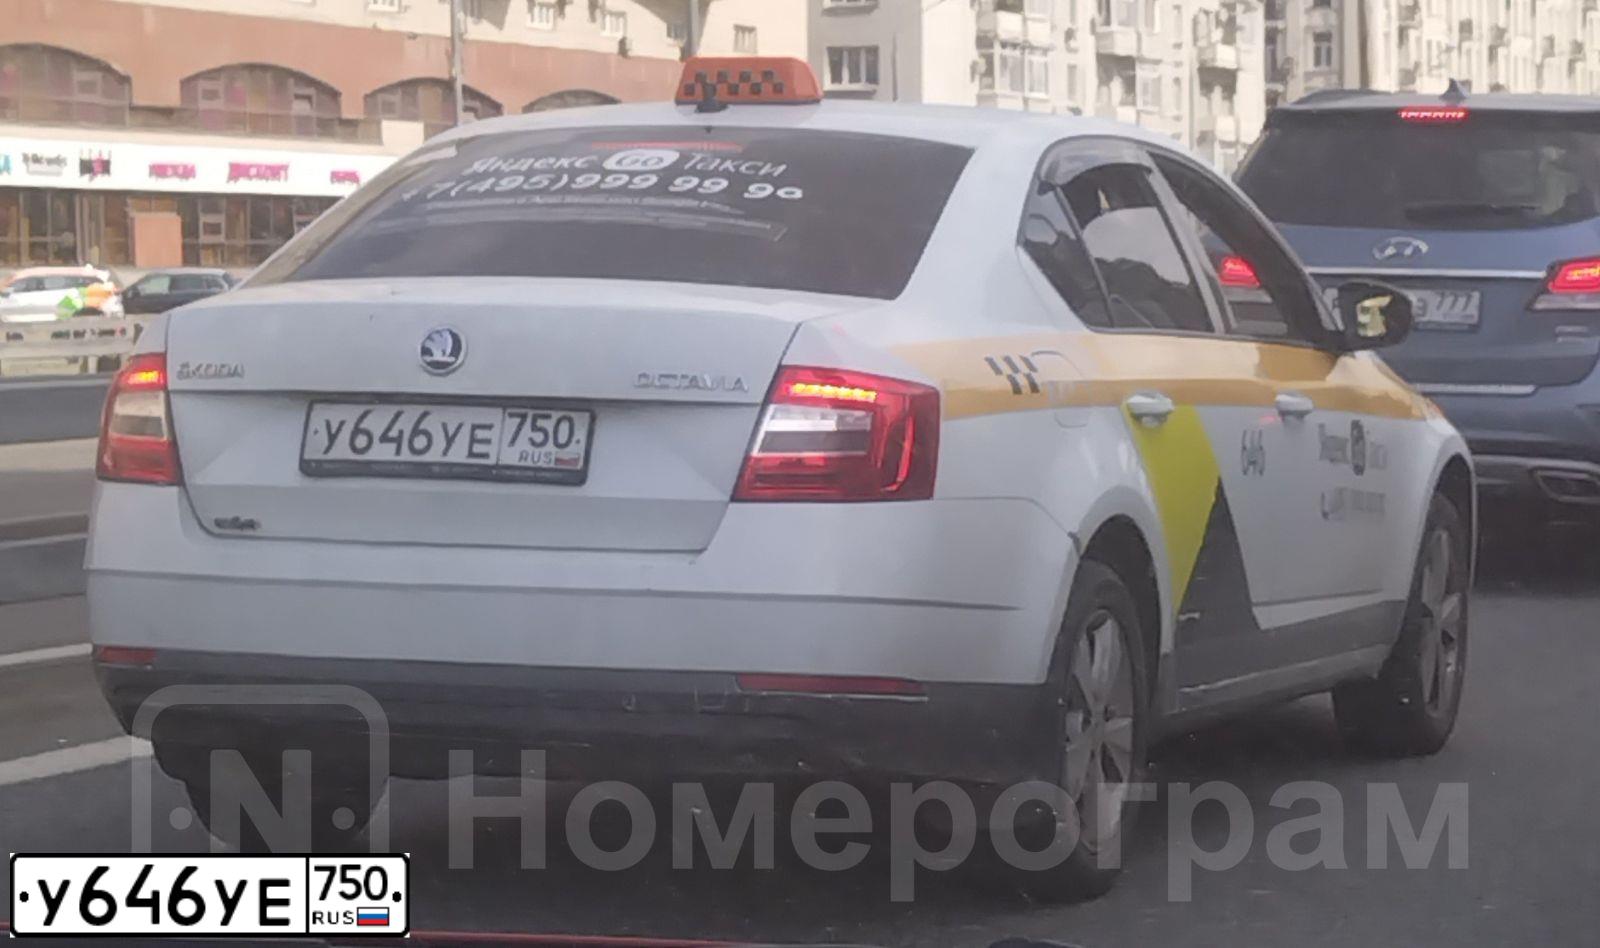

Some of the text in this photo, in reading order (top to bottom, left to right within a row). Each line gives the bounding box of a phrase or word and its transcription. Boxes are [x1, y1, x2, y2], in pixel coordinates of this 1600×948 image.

[684, 152, 788, 177] Такси
[668, 176, 729, 194] 99
[633, 371, 750, 392] OCTAVIA
[322, 408, 576, 460] У646УЕ 750
[518, 450, 553, 466] RUS
